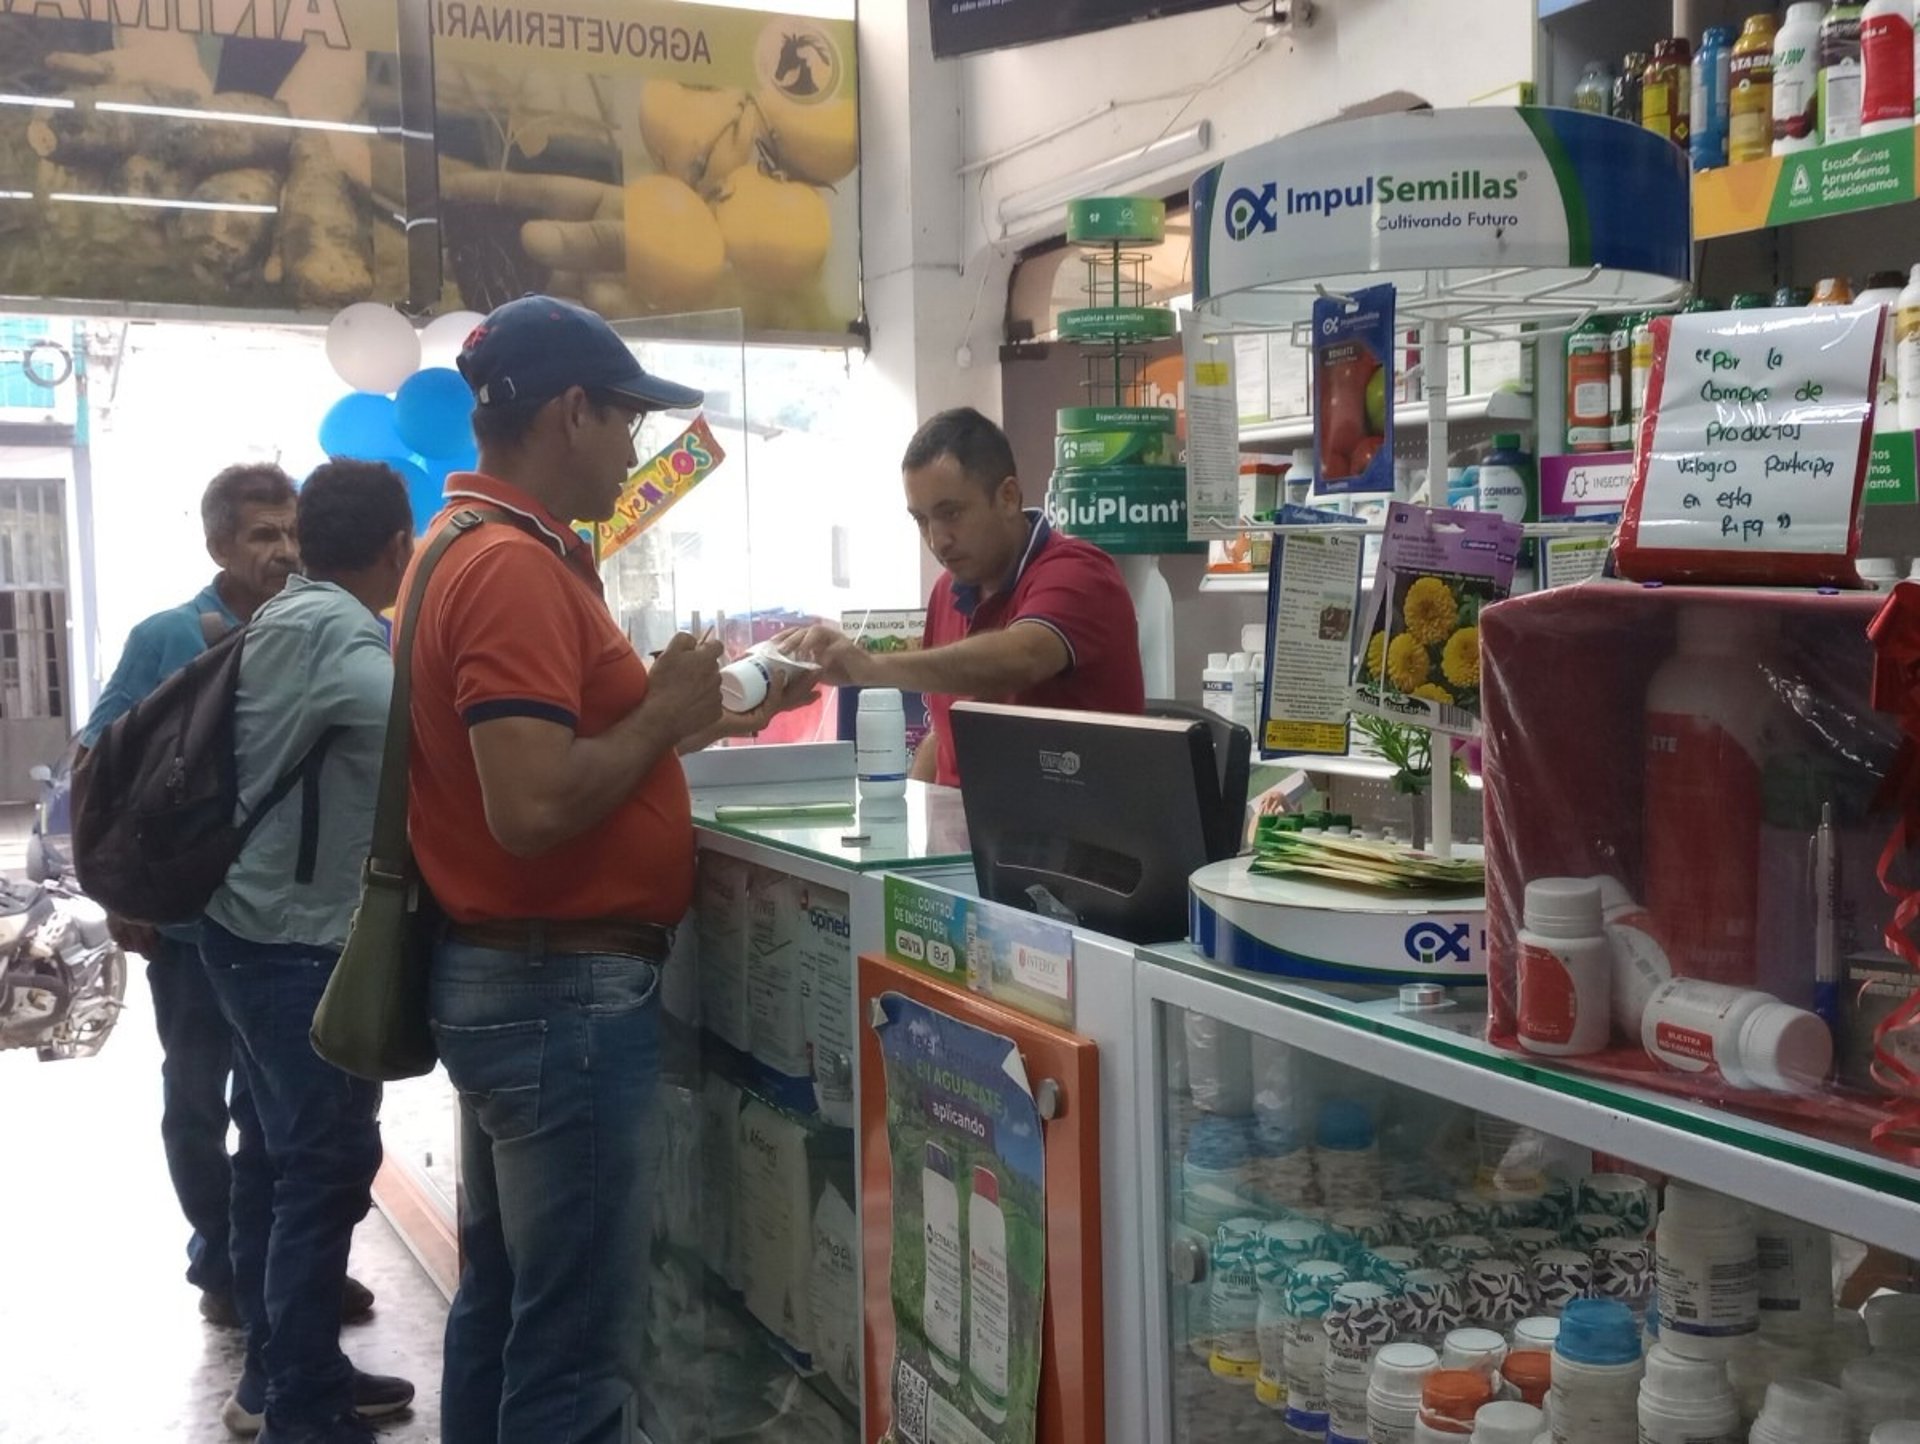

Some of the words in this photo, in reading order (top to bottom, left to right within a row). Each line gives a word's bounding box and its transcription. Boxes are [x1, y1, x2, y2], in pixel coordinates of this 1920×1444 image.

[1821, 164, 1890, 188] Aprendemos
[1822, 177, 1899, 202] Solucionamos
[1378, 211, 1462, 231] Cultivando
[1467, 211, 1519, 227] Futuro
[1766, 347, 1783, 371] la
[1794, 379, 1824, 403] de
[1715, 486, 1752, 509] esta
[918, 896, 955, 921] CONTROL
[905, 909, 945, 935] INSECTOS
[1667, 1031, 1701, 1046] MUESTRA
[932, 1101, 986, 1138] aplicando
